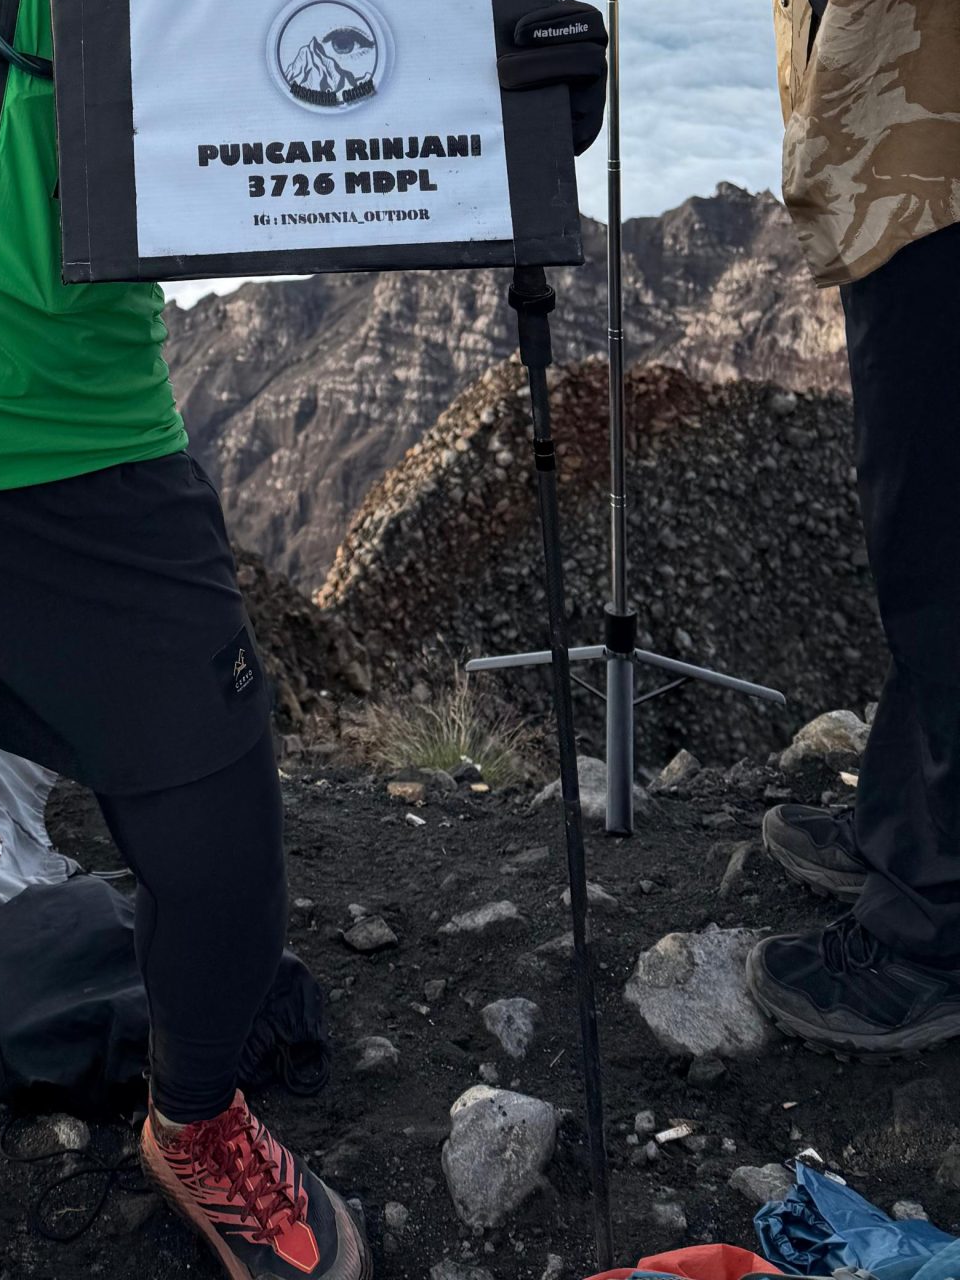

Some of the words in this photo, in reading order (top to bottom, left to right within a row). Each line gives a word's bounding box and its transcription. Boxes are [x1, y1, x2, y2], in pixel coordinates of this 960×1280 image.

[533, 22, 589, 38] Naturehike
[198, 139, 337, 167] PUNCAK
[345, 134, 482, 161] RINJANI
[248, 172, 335, 198] 3726
[344, 169, 438, 194] MDPL
[281, 208, 431, 225] INSOMNIA_OUTDOR
